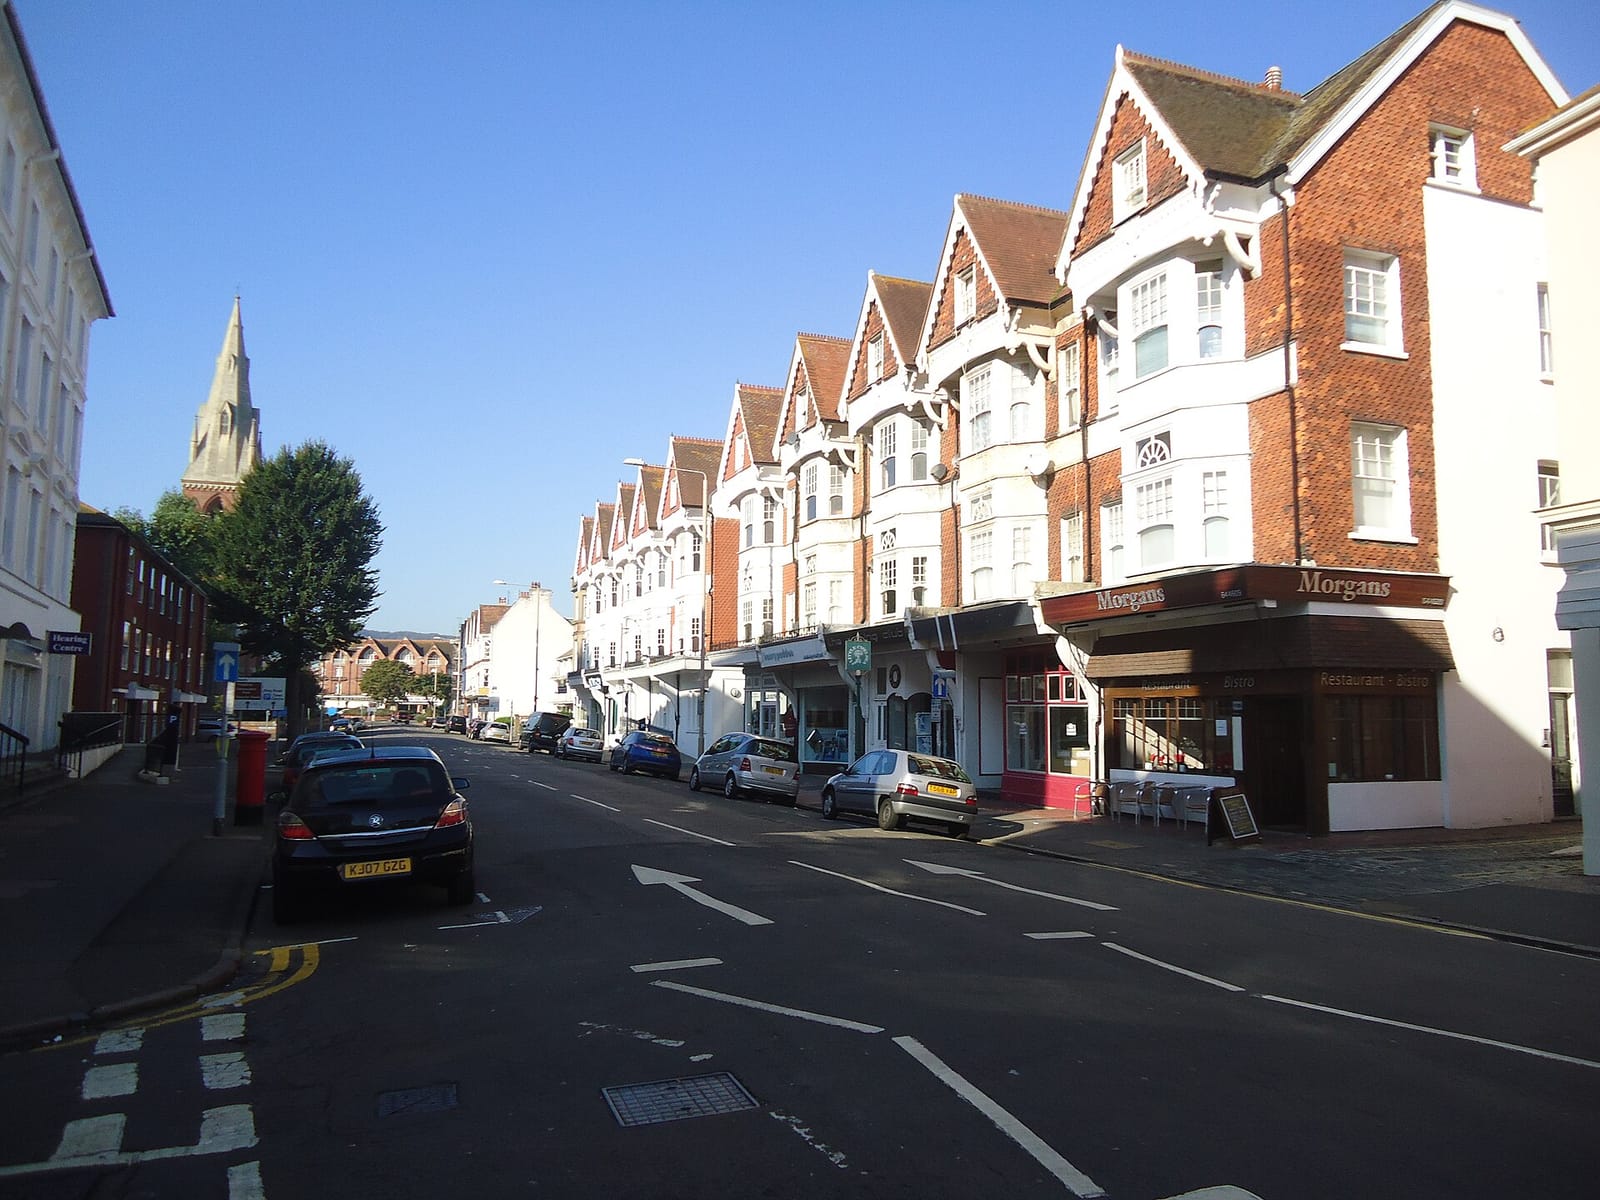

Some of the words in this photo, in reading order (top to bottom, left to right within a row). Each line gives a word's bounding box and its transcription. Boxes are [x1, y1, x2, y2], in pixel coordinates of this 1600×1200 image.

[1297, 571, 1391, 601] Morgans
[1095, 586, 1166, 612] Morgans
[53, 634, 89, 645] Hearing
[53, 643, 84, 653] Centre
[1141, 679, 1191, 690] Restaurant
[1223, 675, 1255, 688] Bistro
[1320, 672, 1384, 686] Restaurant
[1396, 674, 1429, 688] Bistro
[169, 715, 177, 723] P
[349, 863, 380, 876] KJ07
[383, 859, 406, 872] GZG
